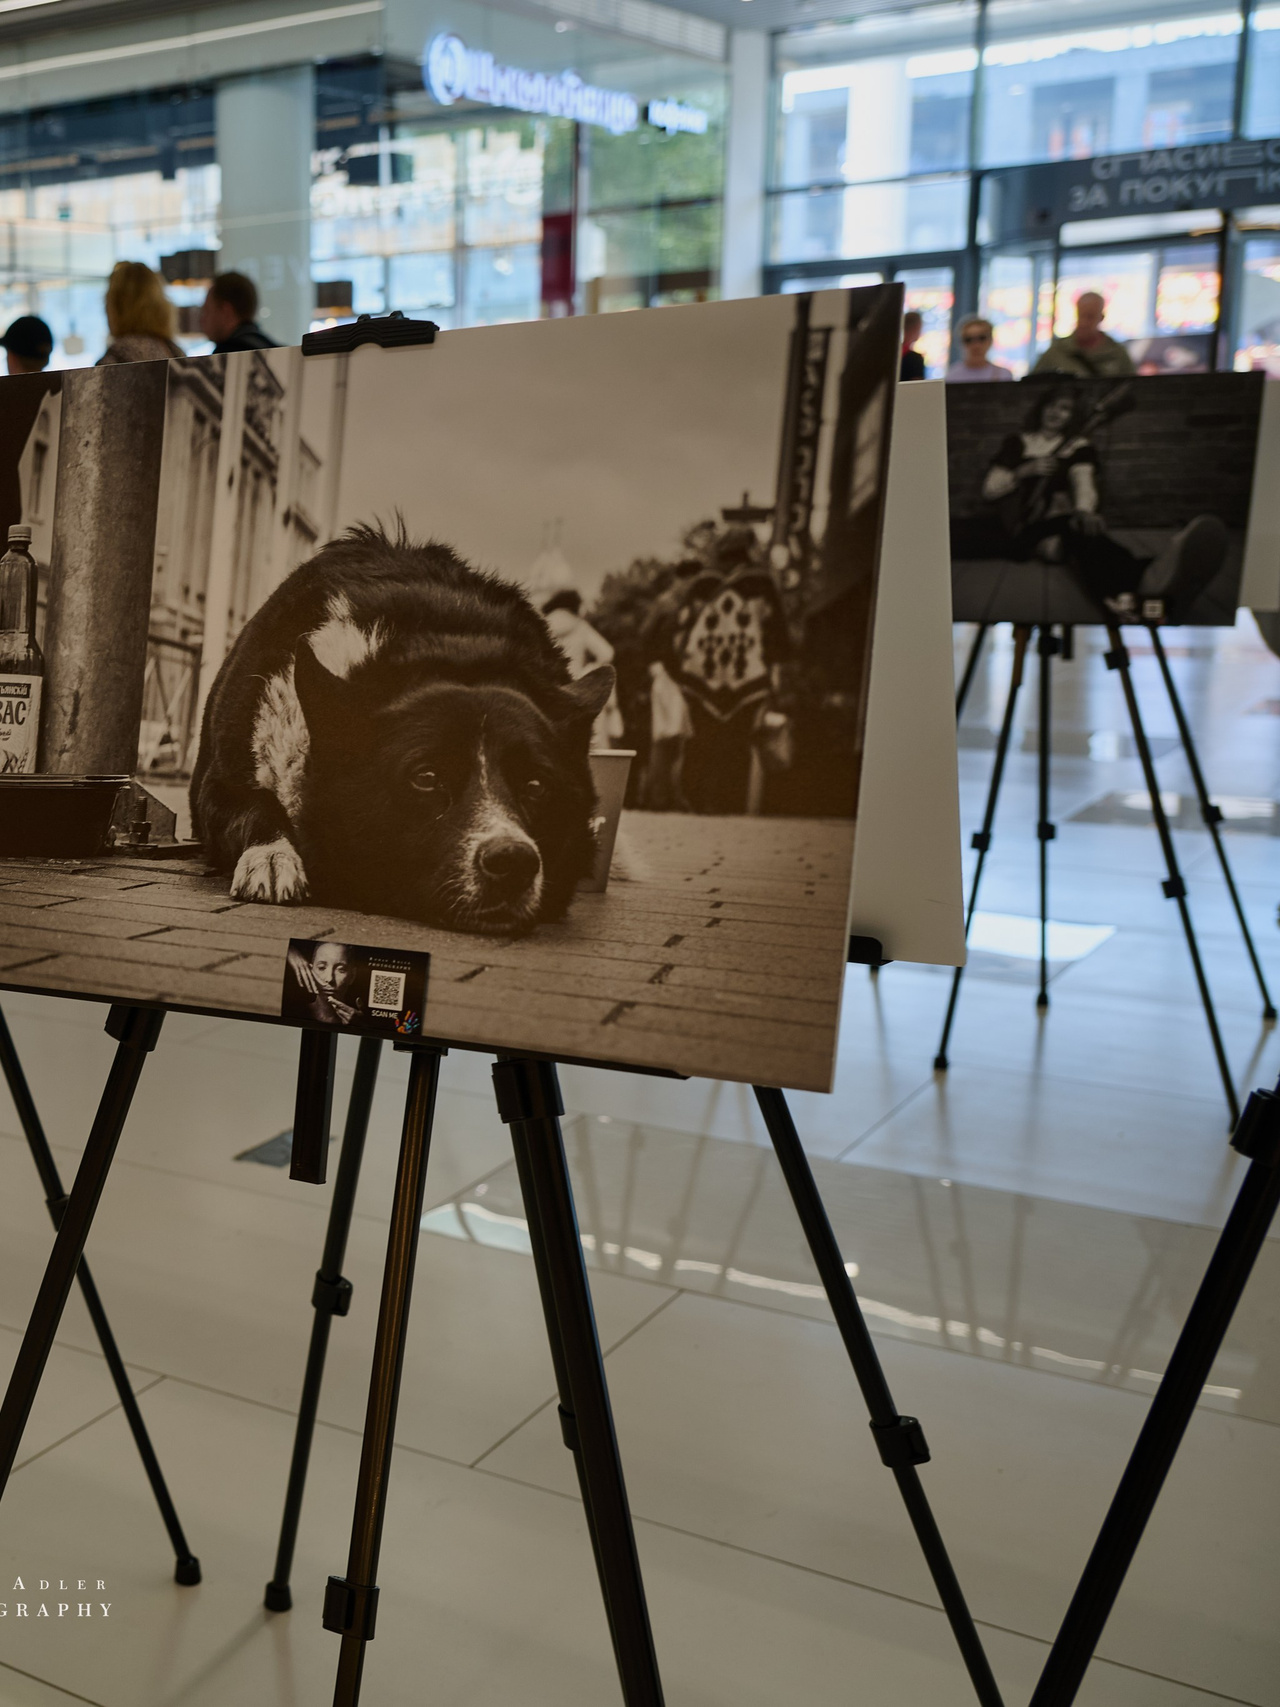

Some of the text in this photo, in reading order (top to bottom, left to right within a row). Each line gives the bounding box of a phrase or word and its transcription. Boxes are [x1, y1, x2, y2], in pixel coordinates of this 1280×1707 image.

[1069, 182, 1109, 213] ЗА
[371, 1009, 399, 1019] SCAN ME
